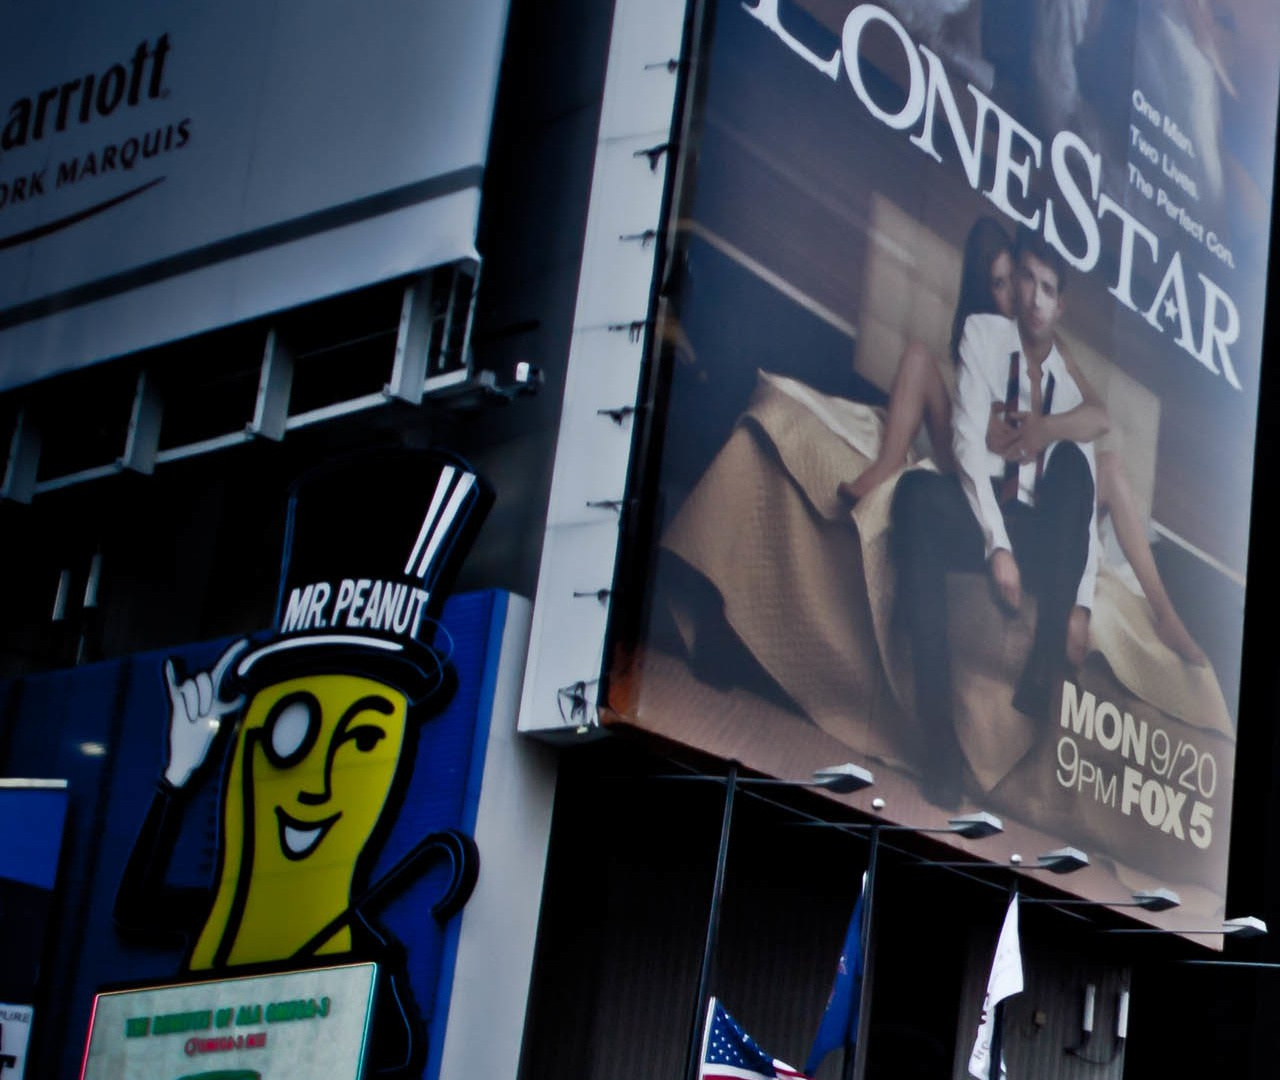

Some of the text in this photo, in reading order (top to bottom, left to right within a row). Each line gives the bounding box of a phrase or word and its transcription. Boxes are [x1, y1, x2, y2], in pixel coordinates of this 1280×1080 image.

[56, 117, 192, 186] MARQUIS
[1130, 123, 1198, 200] Two Lives.
[1131, 89, 1197, 158] One Man.
[1127, 163, 1235, 269] The Perfect Con.
[281, 579, 429, 638] MR. PEANUT
[1060, 680, 1217, 799] MON 9/20
[1056, 736, 1214, 849] 9PM FOX 5
